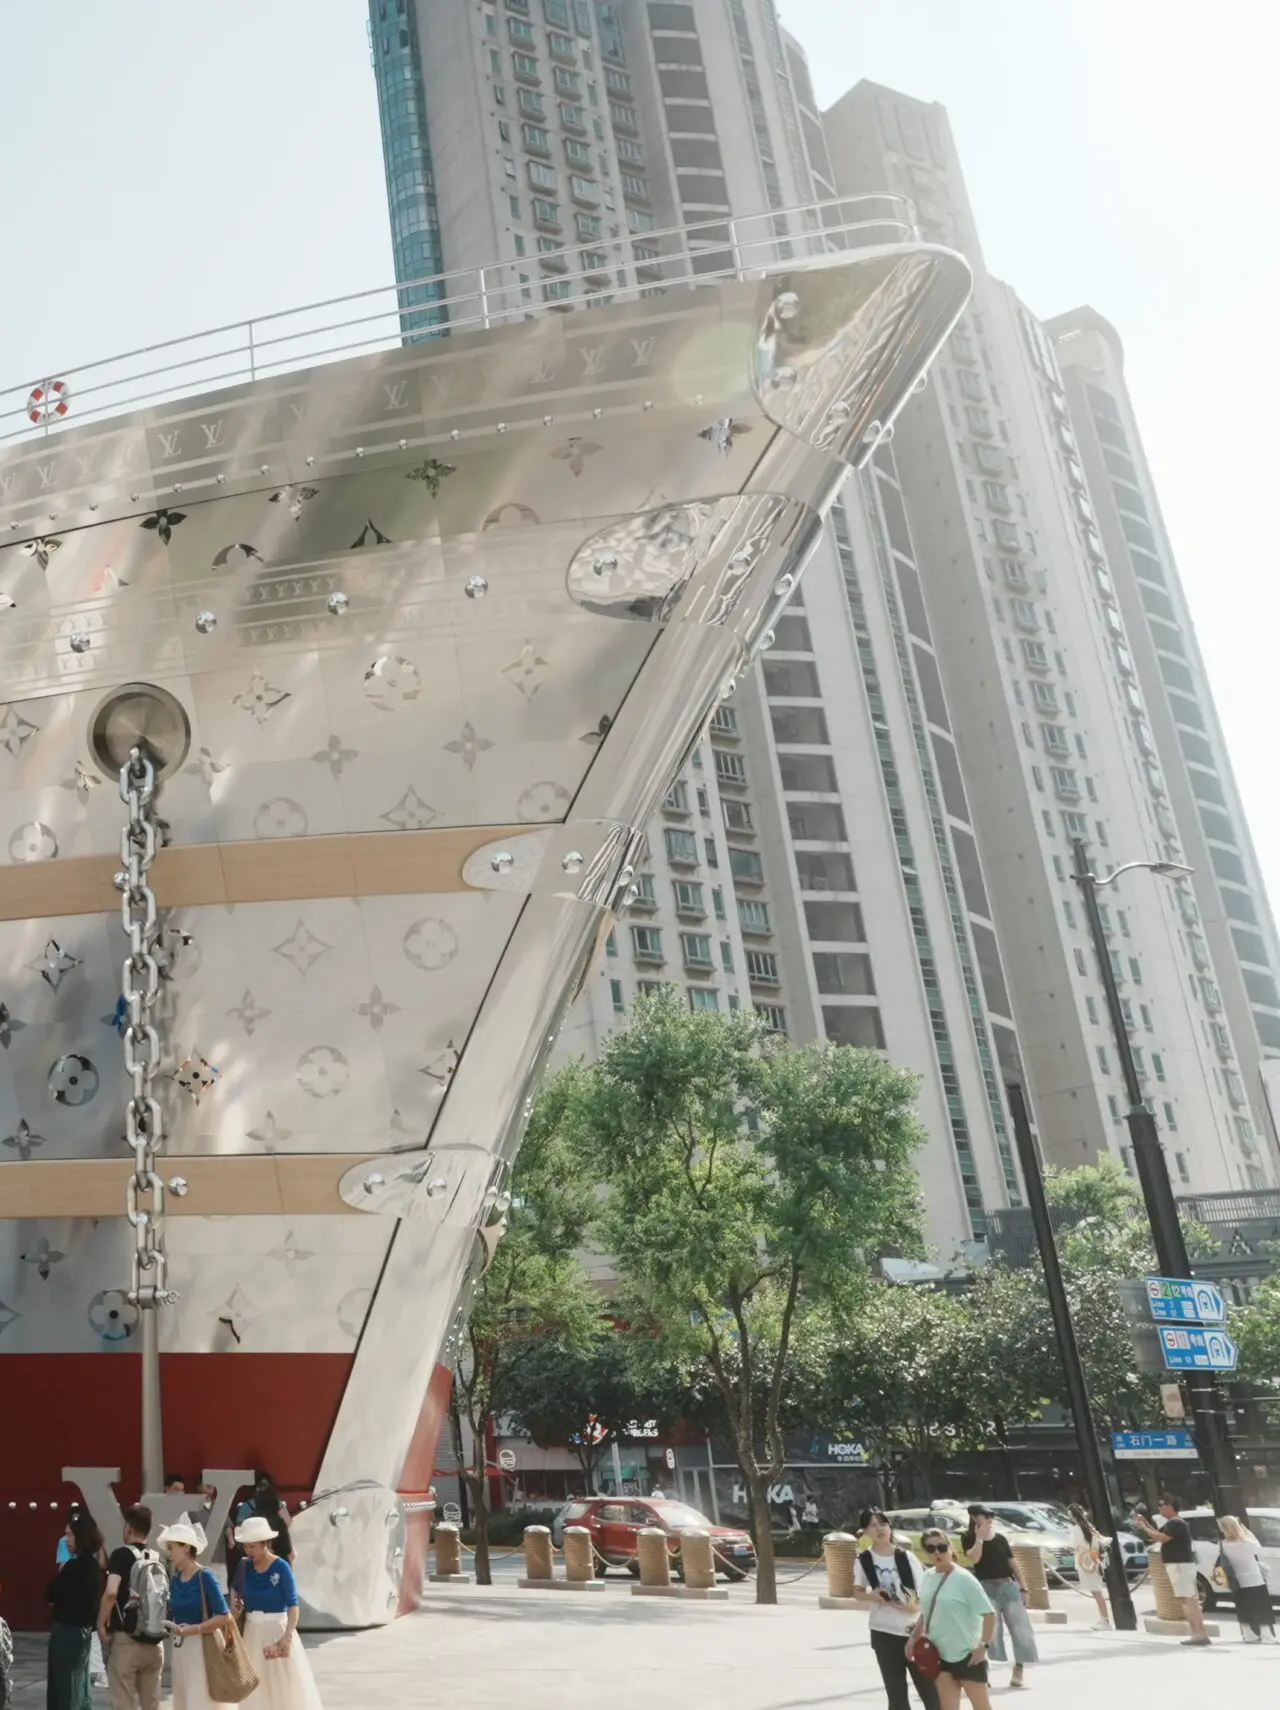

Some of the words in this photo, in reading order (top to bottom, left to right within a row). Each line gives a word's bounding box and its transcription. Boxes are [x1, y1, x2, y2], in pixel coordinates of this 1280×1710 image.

[1129, 1434, 1178, 1447] 石门一路
[828, 1443, 865, 1455] HOKA
[732, 1483, 795, 1503] HKA
